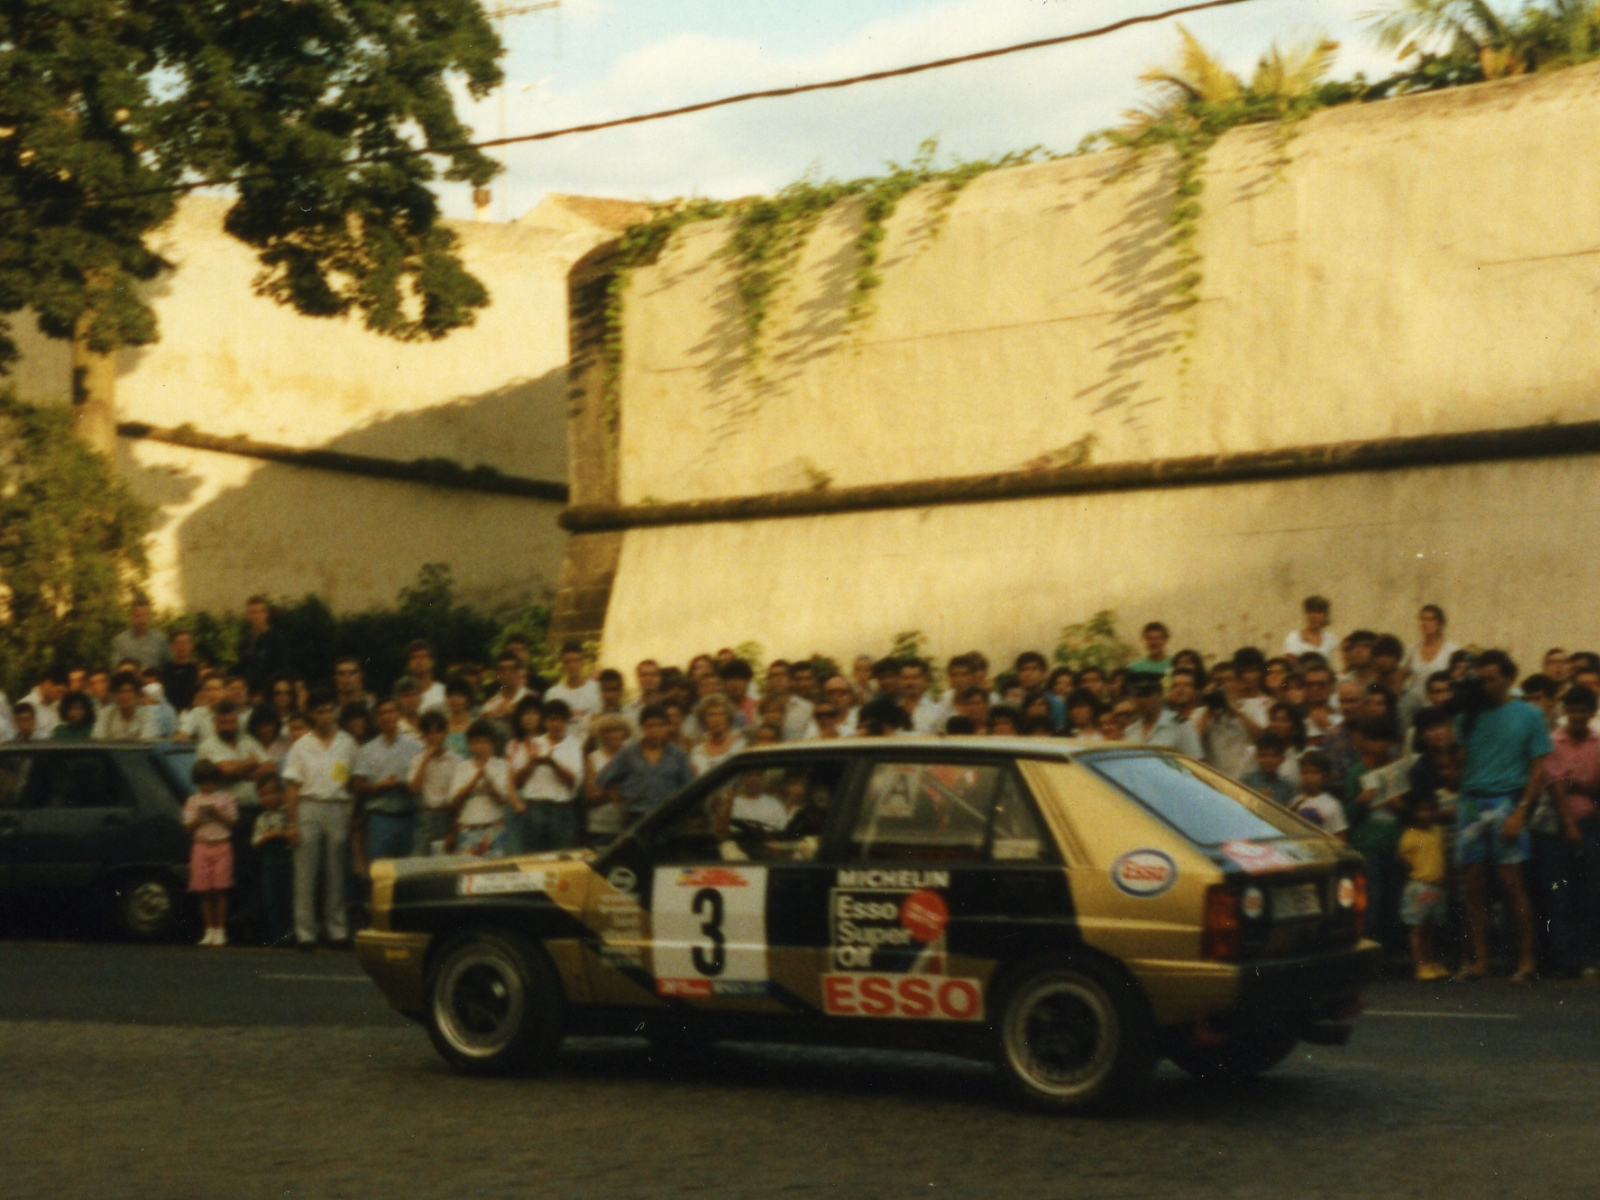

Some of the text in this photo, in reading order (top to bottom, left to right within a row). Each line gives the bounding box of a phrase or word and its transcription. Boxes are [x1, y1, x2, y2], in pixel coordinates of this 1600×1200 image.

[837, 870, 949, 887] MICHELIN
[838, 895, 899, 920] Esso
[691, 887, 726, 976] 3
[823, 976, 981, 1019] ESSO
